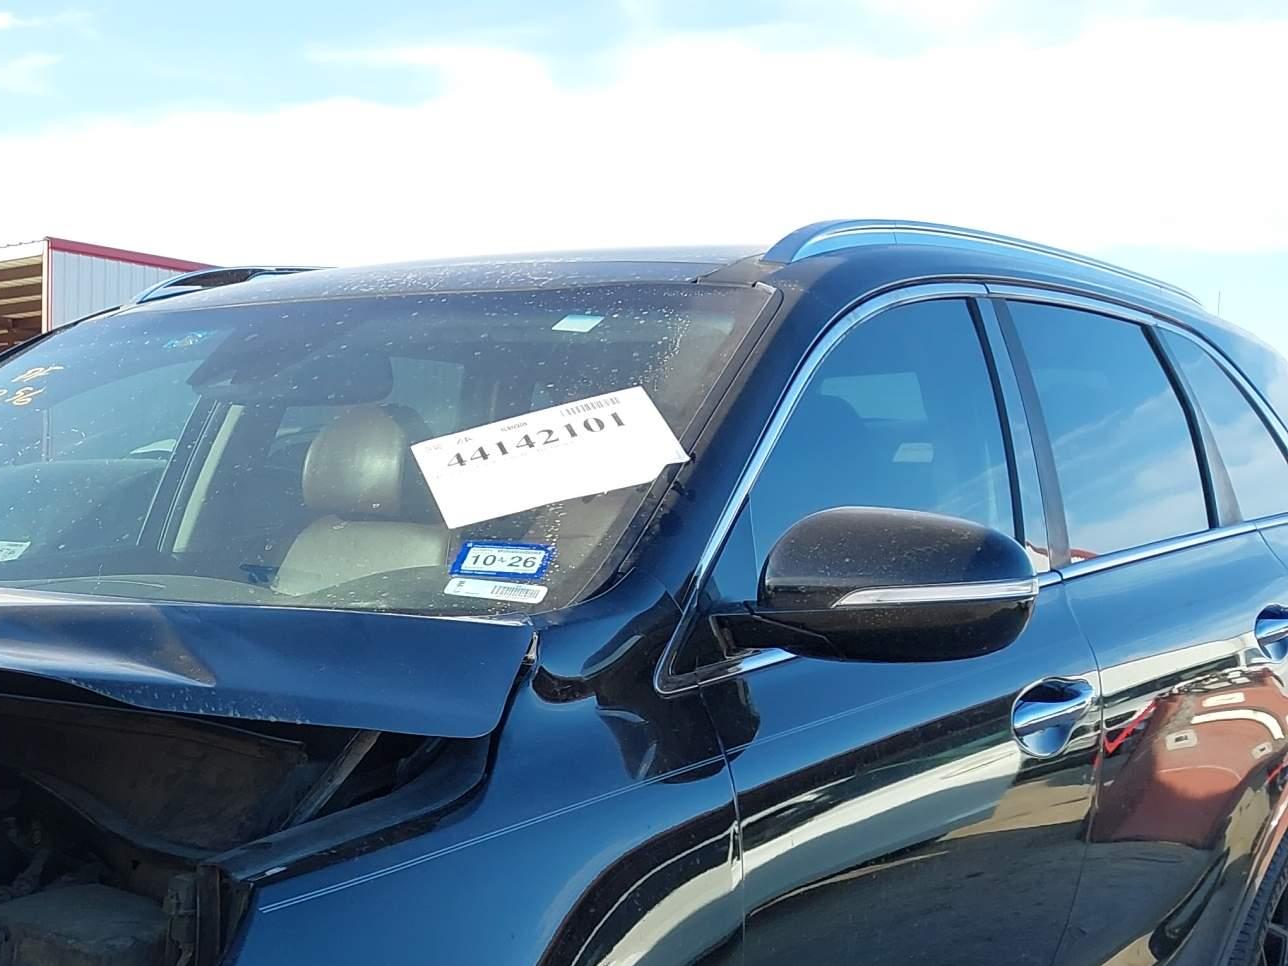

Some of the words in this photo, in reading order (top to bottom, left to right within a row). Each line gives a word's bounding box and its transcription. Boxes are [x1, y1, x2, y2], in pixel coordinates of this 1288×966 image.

[447, 411, 626, 468] 44142101
[471, 554, 497, 566] 10
[506, 555, 537, 568] 26
